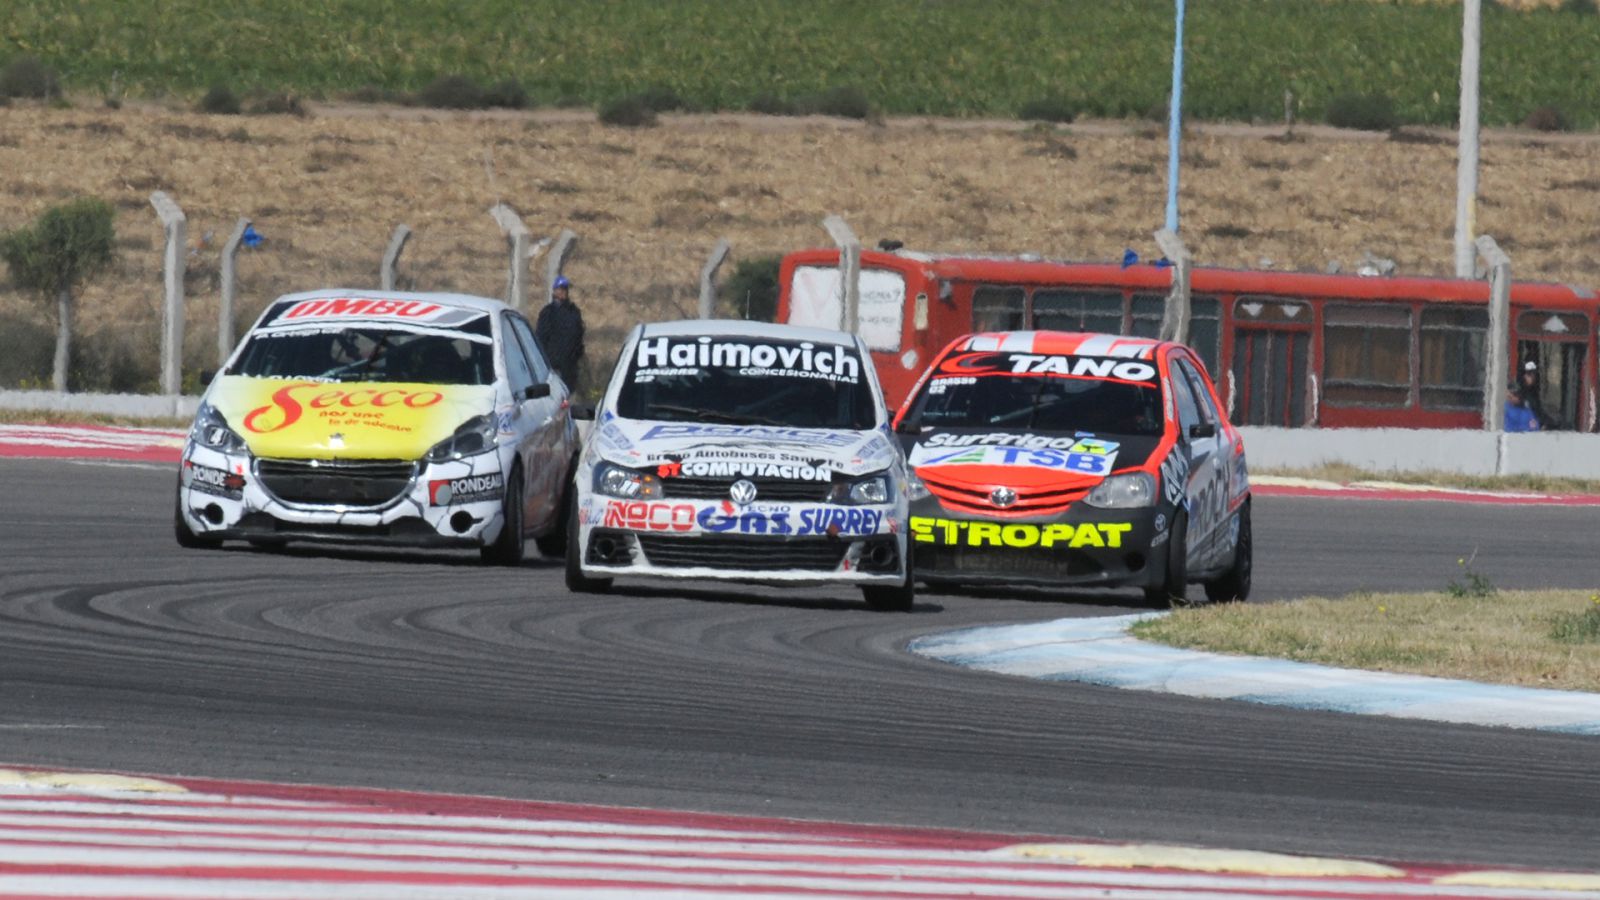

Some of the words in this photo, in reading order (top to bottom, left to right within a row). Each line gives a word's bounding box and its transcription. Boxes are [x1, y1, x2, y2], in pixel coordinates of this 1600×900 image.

[286, 299, 442, 318] OMBU
[637, 337, 859, 377] Haimovich
[1008, 354, 1156, 381] TANO
[739, 368, 858, 385] CONCESIONARIAS
[243, 383, 443, 433] Secco
[924, 432, 1075, 451] SurFrigo
[694, 449, 776, 461] Autobuses
[994, 446, 1107, 473] TSB
[192, 466, 227, 487] RONDE
[740, 504, 791, 513] TECNO
[798, 508, 882, 535] SURREY
[909, 516, 1132, 548] ETROPAT
